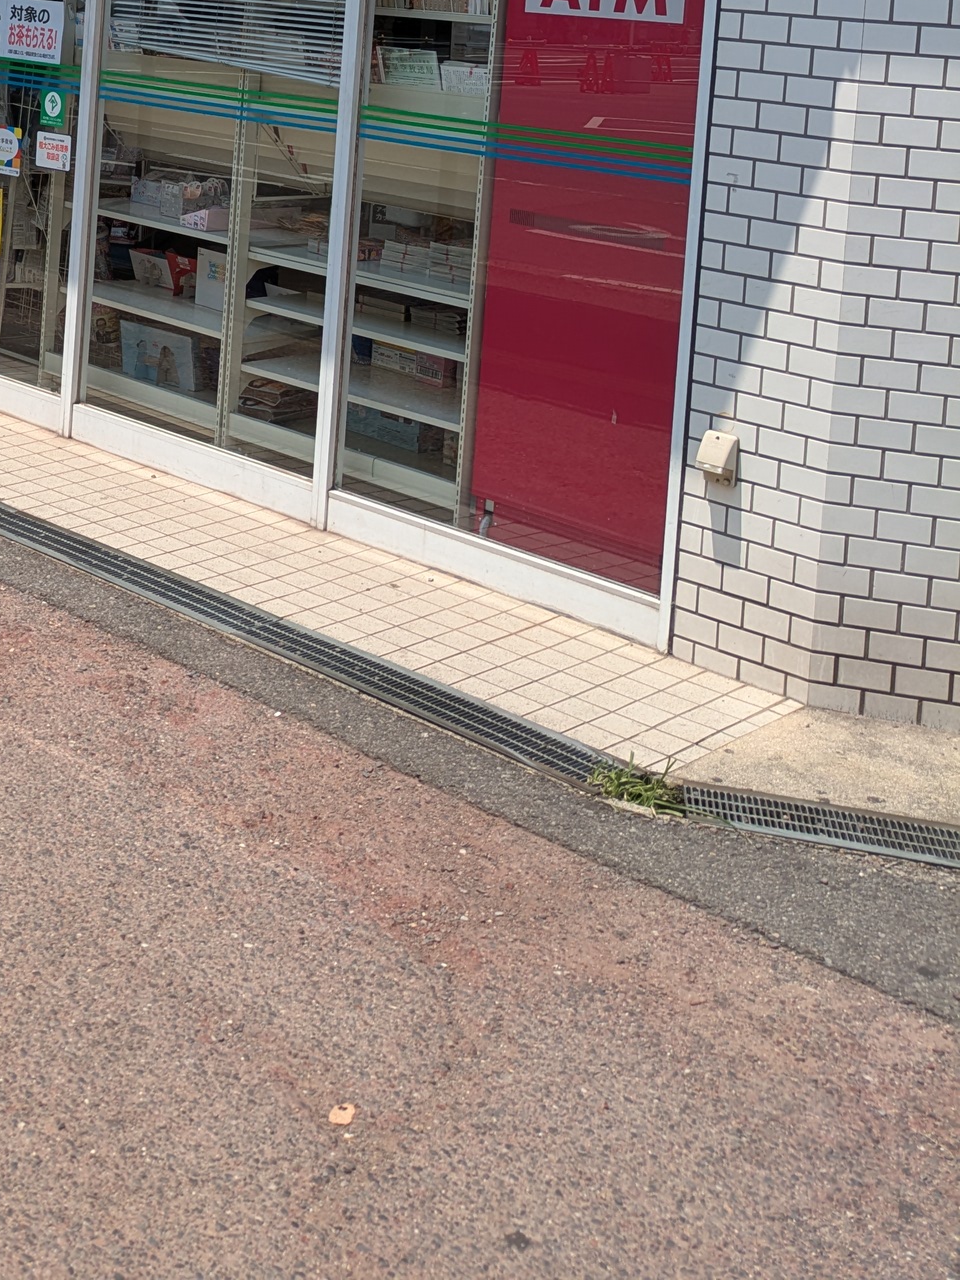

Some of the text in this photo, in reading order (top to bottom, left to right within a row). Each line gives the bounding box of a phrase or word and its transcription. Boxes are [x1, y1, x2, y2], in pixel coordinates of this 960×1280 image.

[9, 4, 50, 24] 対象の
[8, 23, 58, 51] お茶もらえる!
